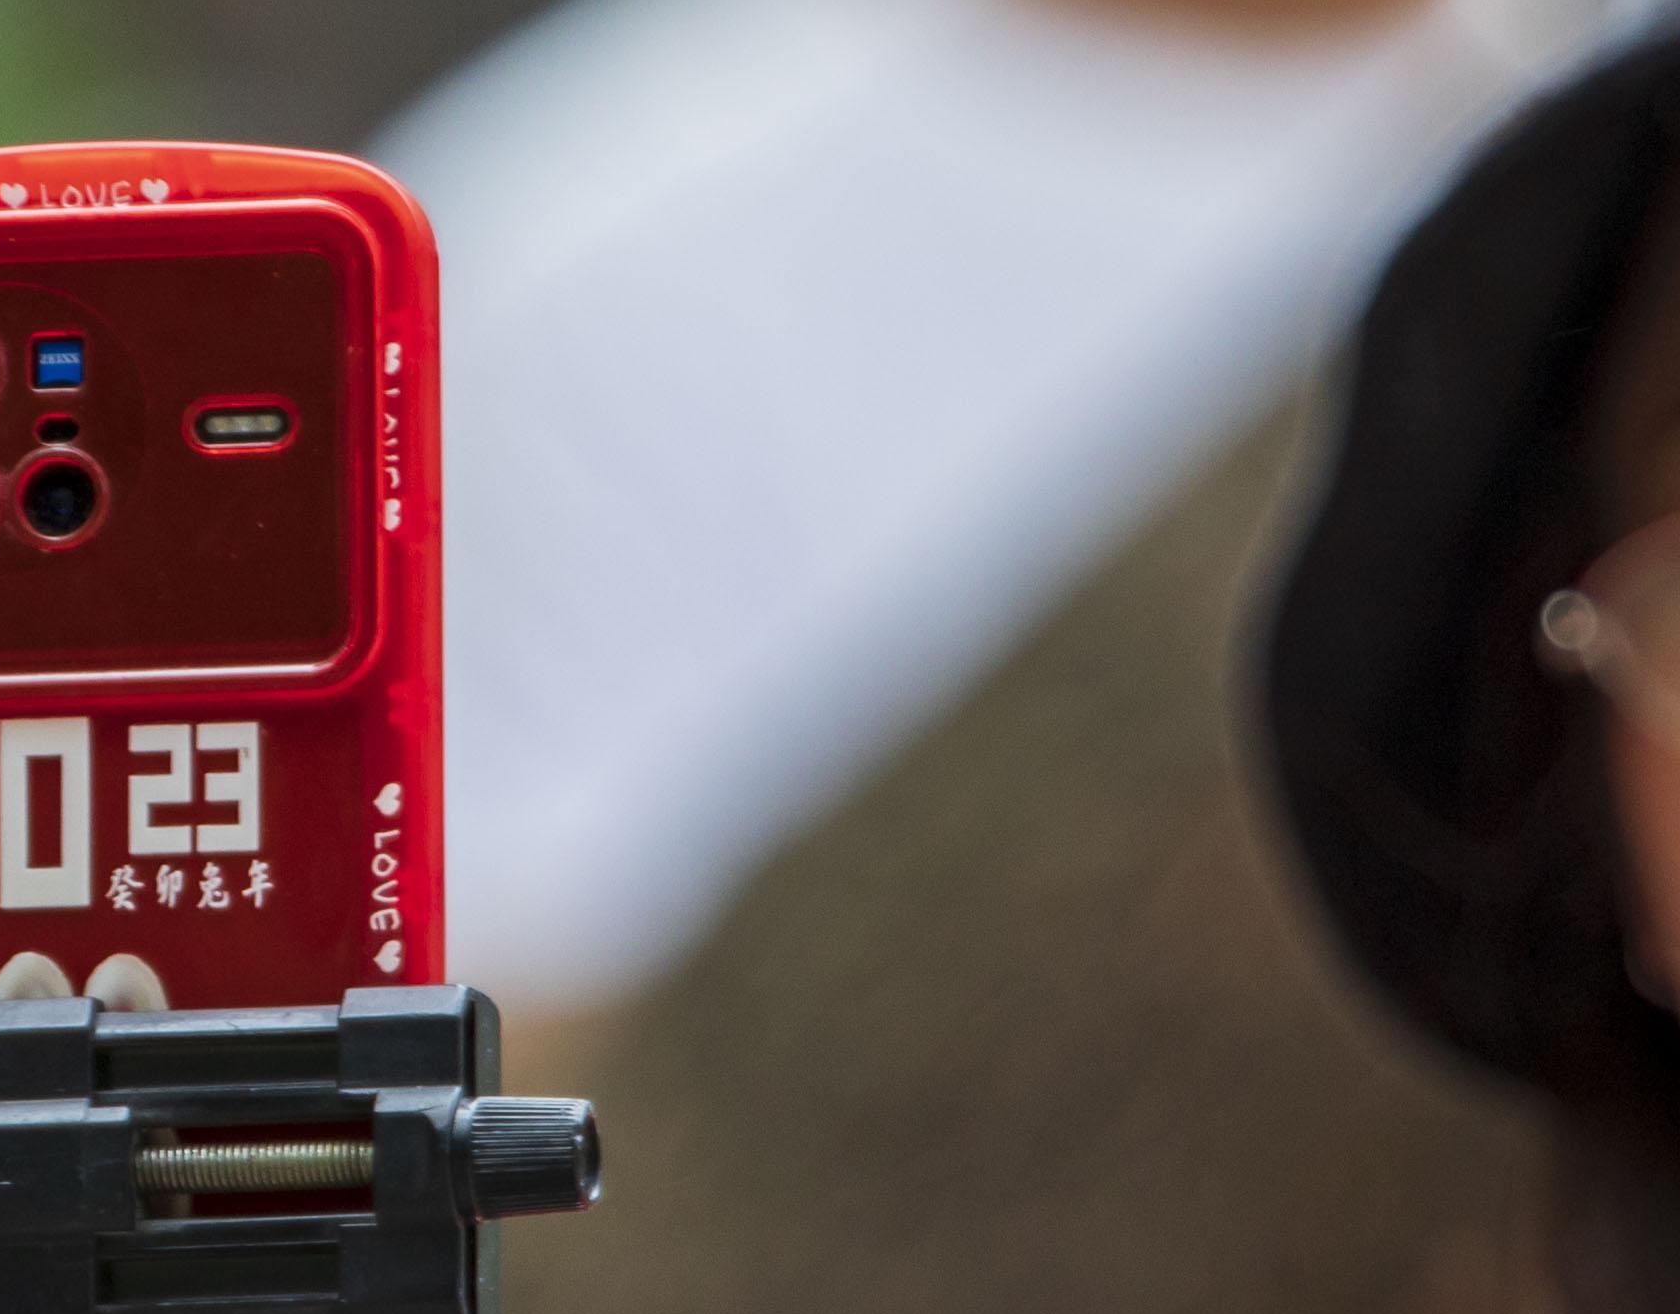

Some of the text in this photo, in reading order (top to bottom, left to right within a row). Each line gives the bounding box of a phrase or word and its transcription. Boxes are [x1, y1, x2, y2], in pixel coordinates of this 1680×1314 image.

[40, 180, 133, 208] LOVE
[105, 858, 275, 911] 癸卯兔年
[369, 829, 401, 932] LOVE
